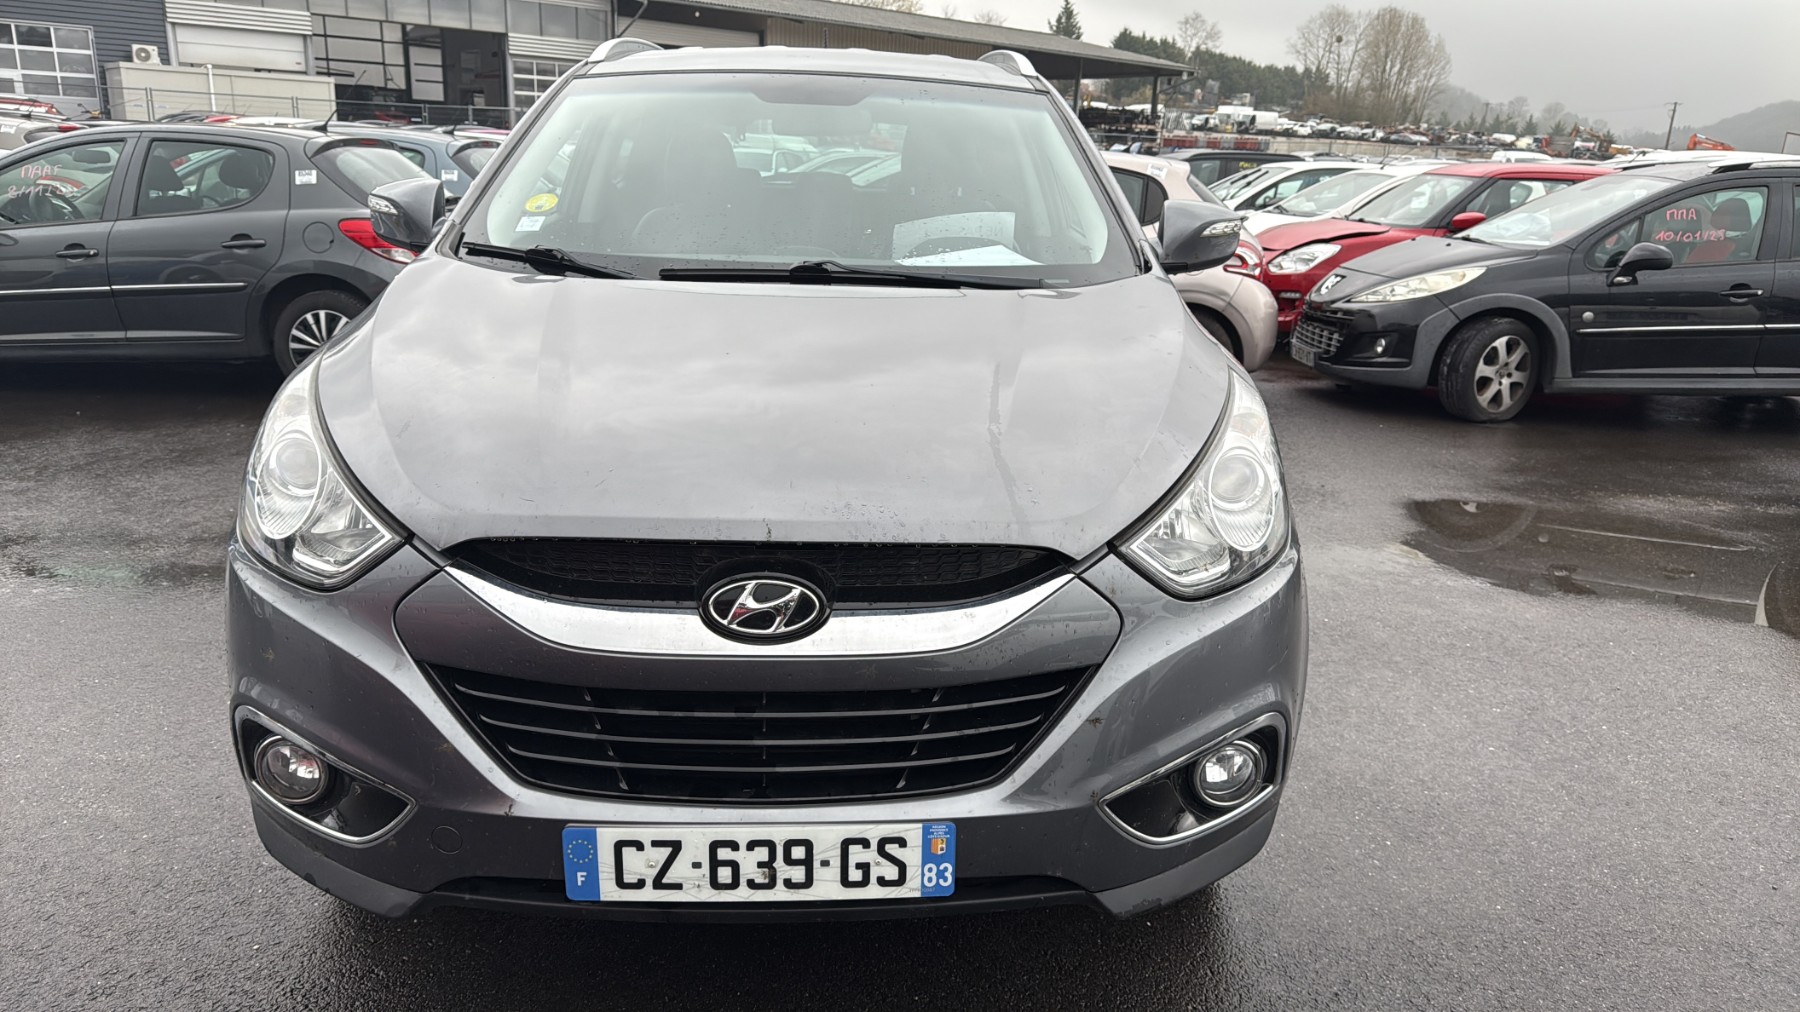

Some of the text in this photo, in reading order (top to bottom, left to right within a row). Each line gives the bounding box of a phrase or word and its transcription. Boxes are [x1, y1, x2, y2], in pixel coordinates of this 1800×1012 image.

[613, 836, 908, 891] CZ-639-GS
[923, 862, 953, 887] 83
[576, 871, 587, 886] F
